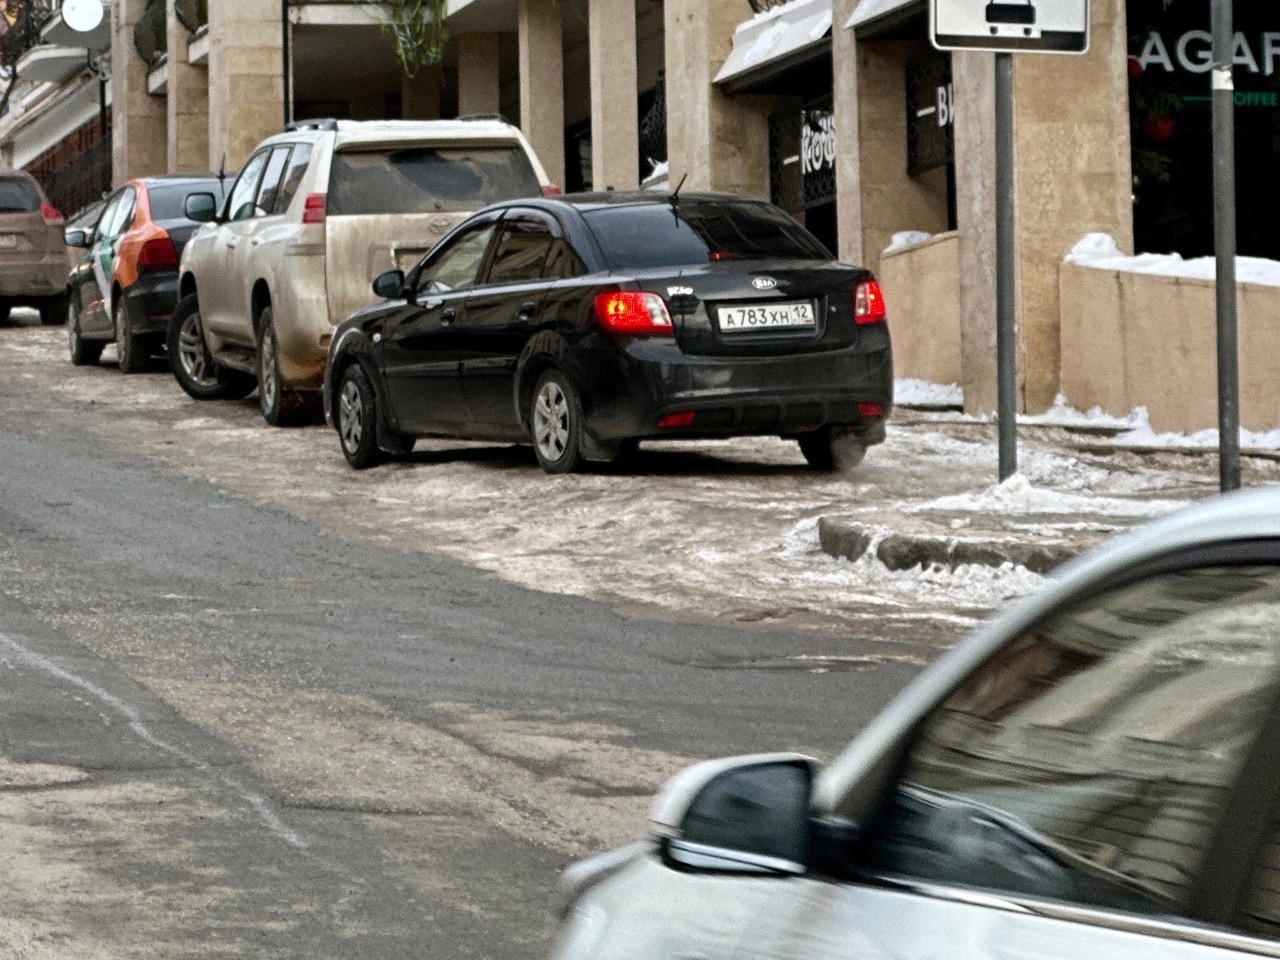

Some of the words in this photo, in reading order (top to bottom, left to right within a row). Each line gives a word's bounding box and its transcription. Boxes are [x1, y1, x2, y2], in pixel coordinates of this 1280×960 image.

[1233, 91, 1277, 107] OFFEE
[726, 308, 789, 327] А783ХН
[793, 305, 808, 319] 12
